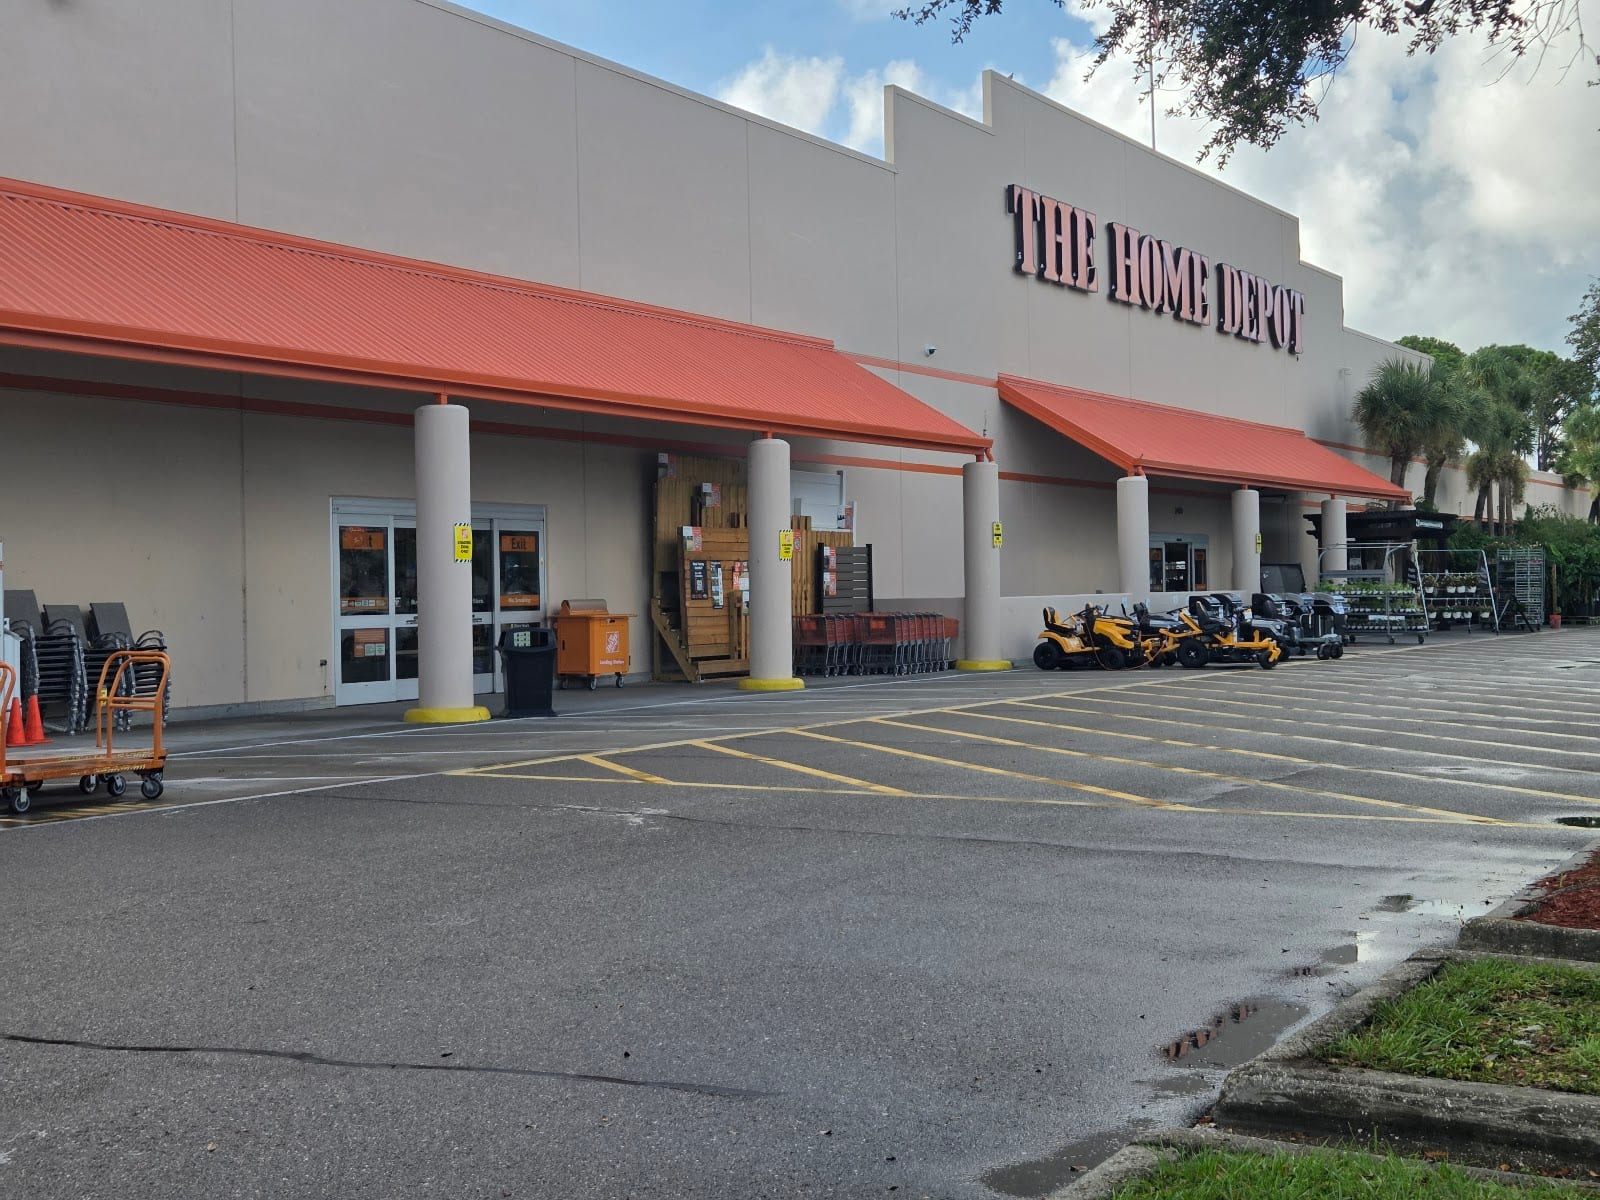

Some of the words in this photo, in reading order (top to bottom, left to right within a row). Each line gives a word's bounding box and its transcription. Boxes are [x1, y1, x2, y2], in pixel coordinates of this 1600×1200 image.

[1007, 184, 1098, 292] THE
[1108, 222, 1210, 325] HOME
[1217, 263, 1304, 354] DEPOT
[511, 537, 527, 550] Exit
